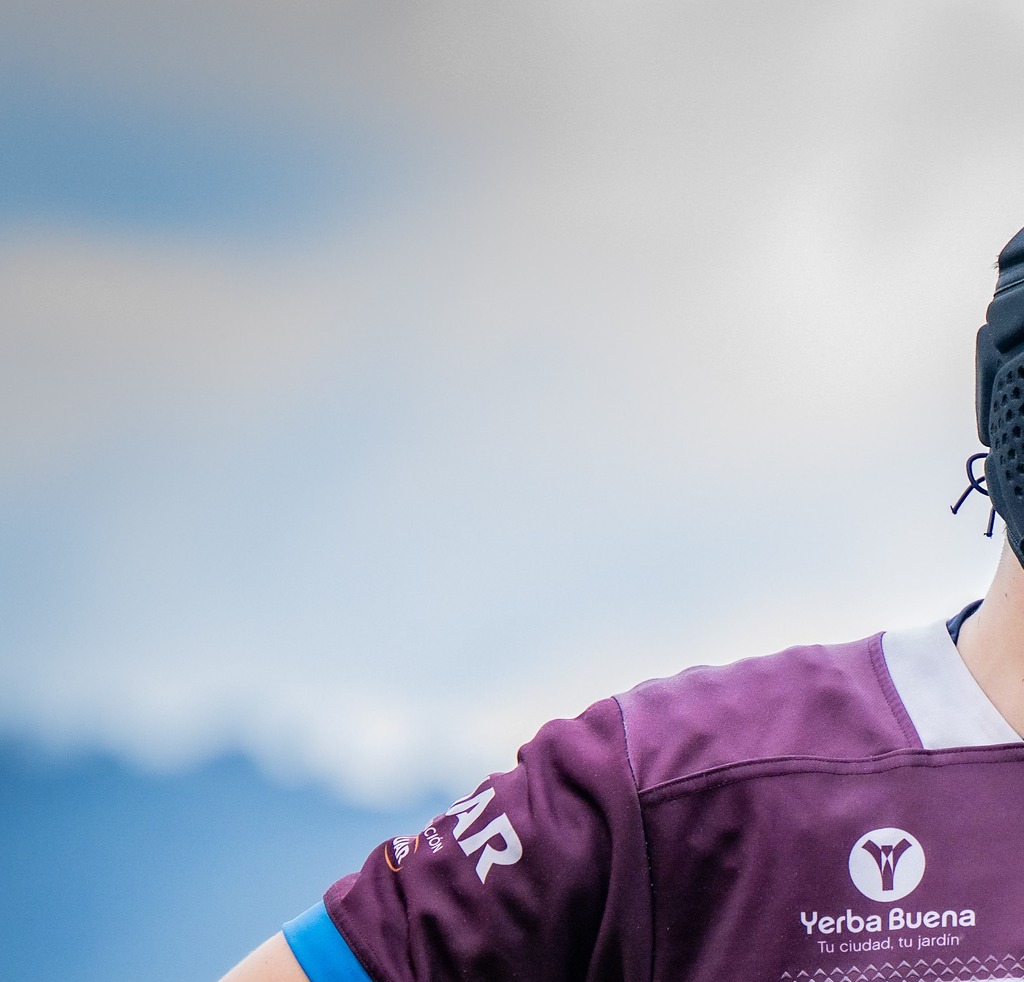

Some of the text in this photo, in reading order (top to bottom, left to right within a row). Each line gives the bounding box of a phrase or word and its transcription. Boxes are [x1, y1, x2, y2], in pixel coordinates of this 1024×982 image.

[422, 820, 444, 854] CIÓN
[445, 775, 523, 885] AR
[800, 907, 976, 935] Yerba Buena
[817, 933, 960, 954] Tu ciudad, tu jardín
